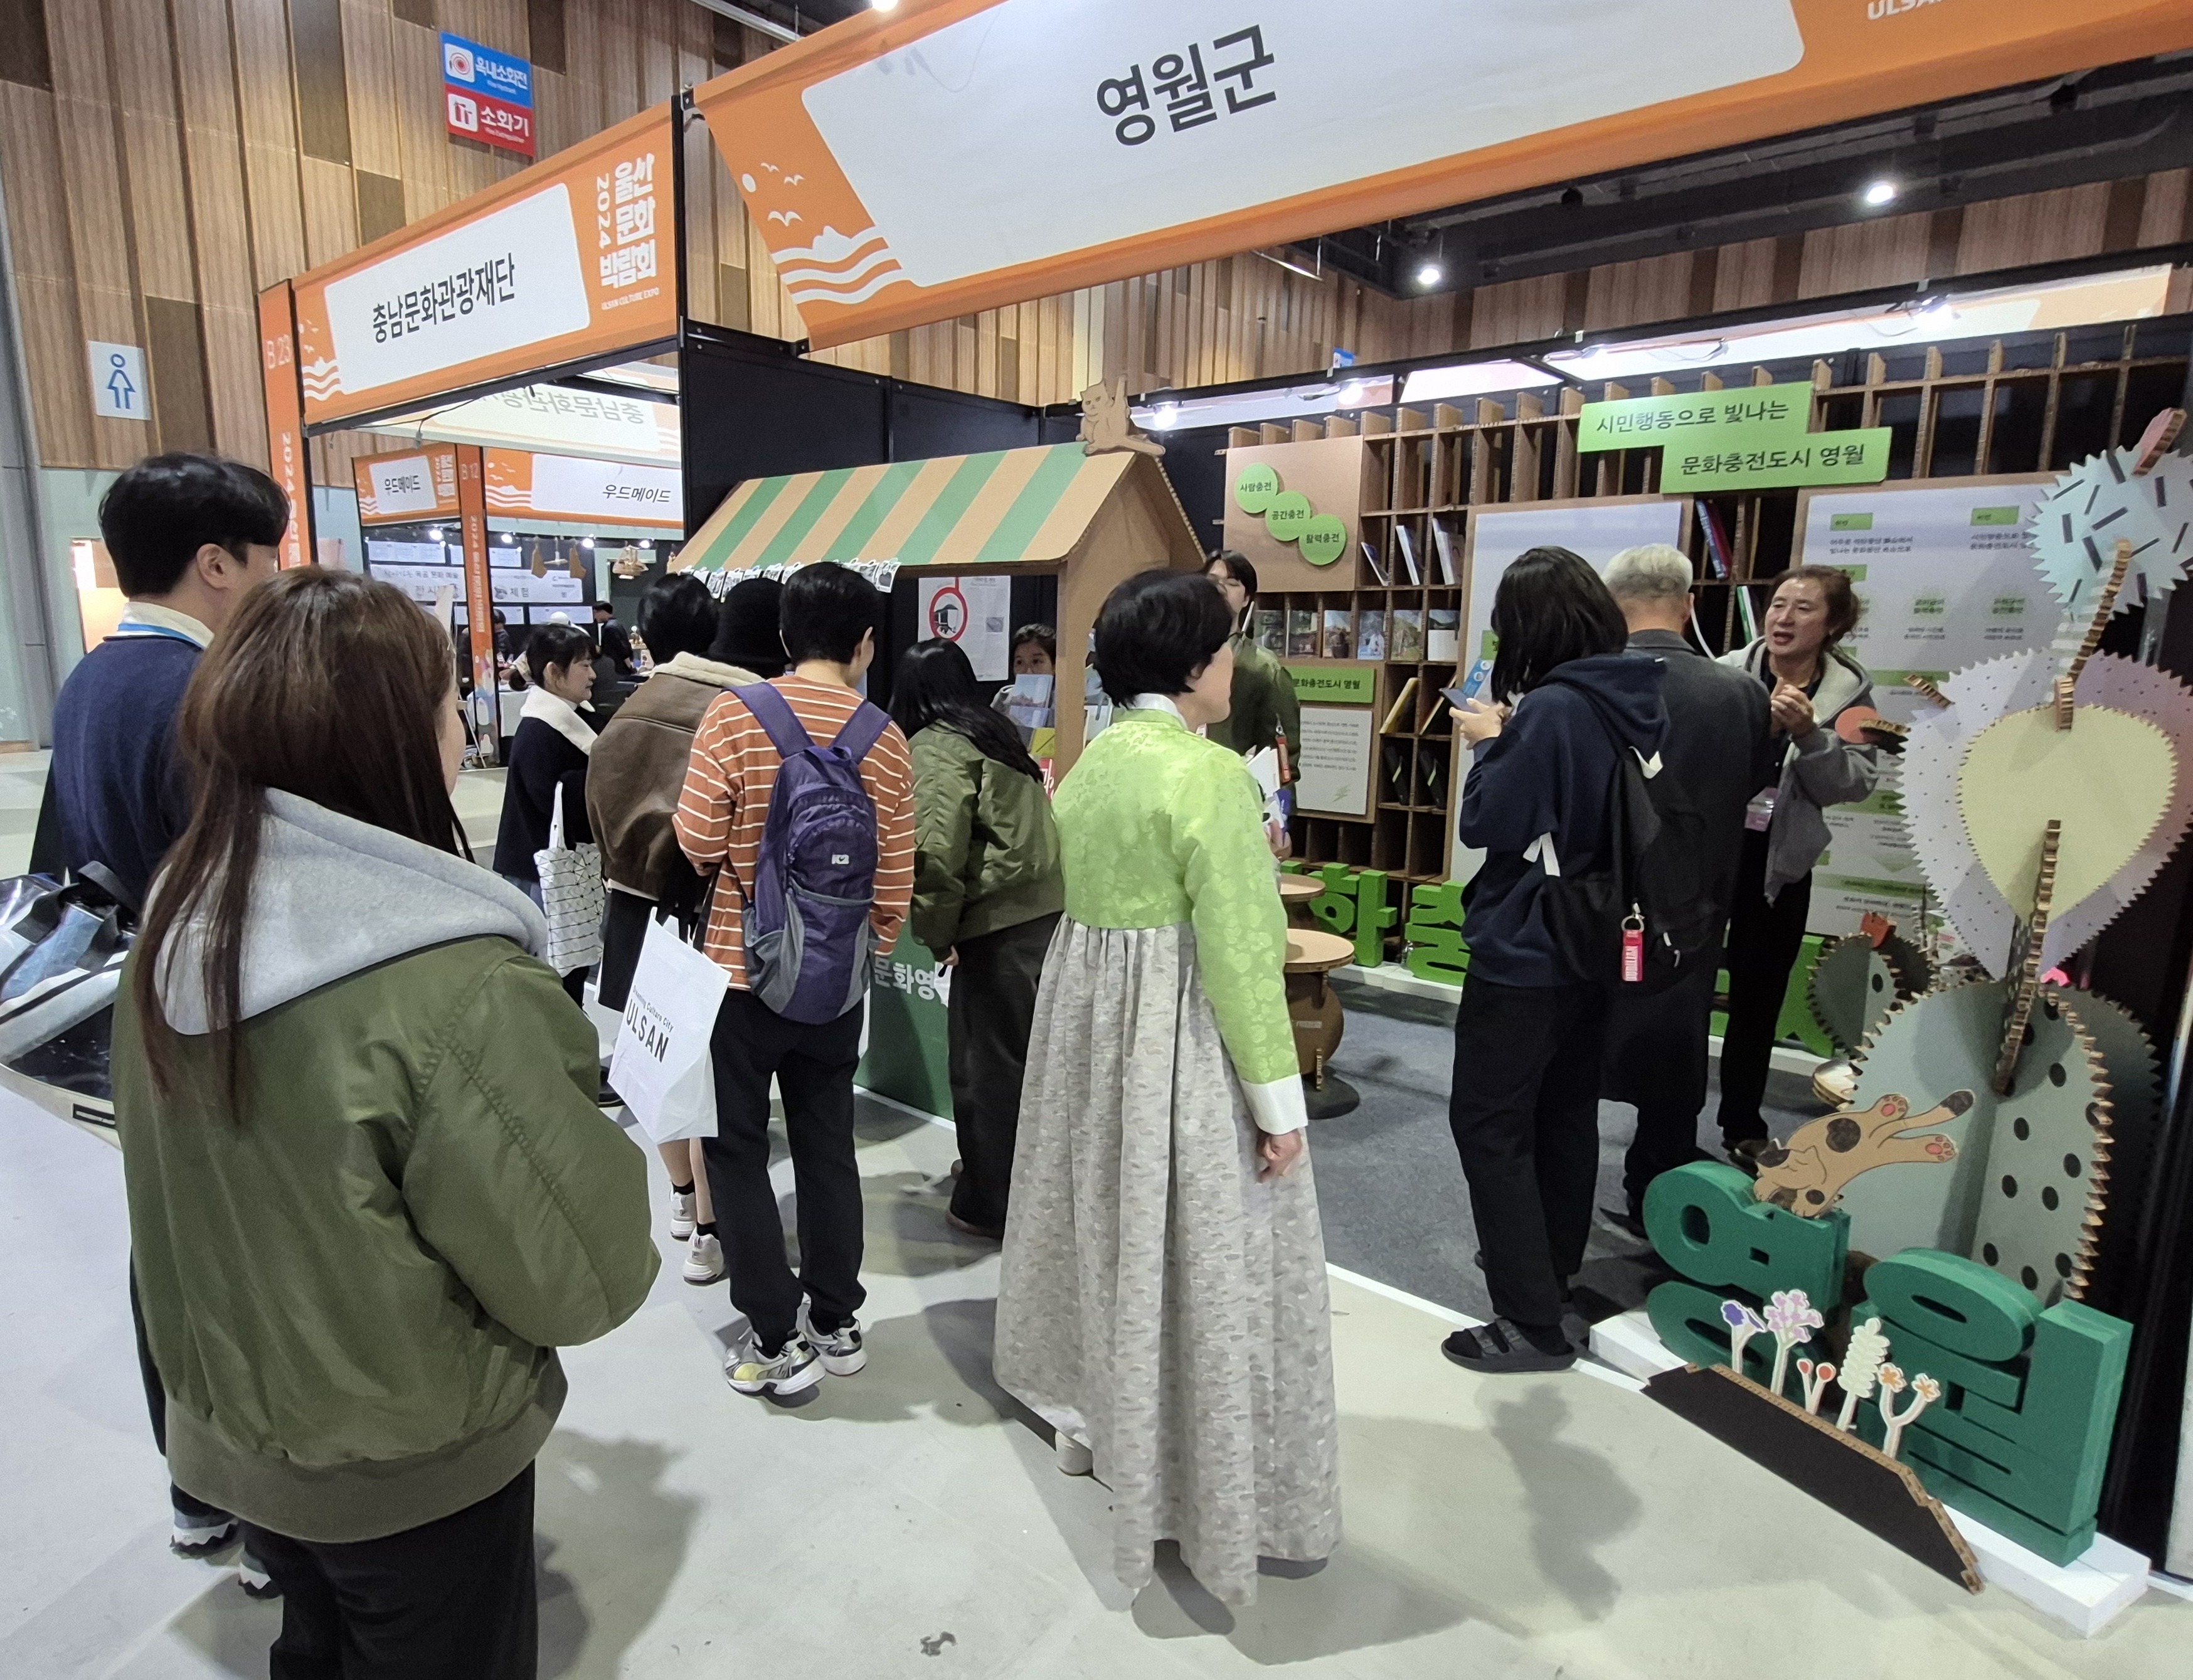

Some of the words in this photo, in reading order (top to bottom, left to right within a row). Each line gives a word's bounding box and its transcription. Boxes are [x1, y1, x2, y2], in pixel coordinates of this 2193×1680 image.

[475, 56, 528, 90] 옥내소화전
[1096, 24, 1277, 146] 영월군
[480, 105, 529, 137] 소화기
[615, 153, 655, 205] 울산
[597, 173, 612, 249] 2024
[615, 196, 656, 245] 문화
[600, 238, 657, 289] 박람회
[373, 252, 515, 343] 충남문화관광재단
[1596, 407, 1717, 433] 시민행동으로
[1724, 400, 1790, 423] 빛나는
[1681, 447, 1812, 476] 문화충전도시
[1820, 444, 1865, 467] 영월
[385, 475, 421, 496] 우드메이드
[602, 484, 672, 503] 우드메이드
[1240, 482, 1272, 492] 사람충전
[1272, 510, 1304, 520] 공간충전
[1306, 533, 1340, 544] 활력충전
[626, 999, 669, 1063] ULSAN
[646, 1002, 662, 1022] Culture
[663, 1017, 674, 1033] City
